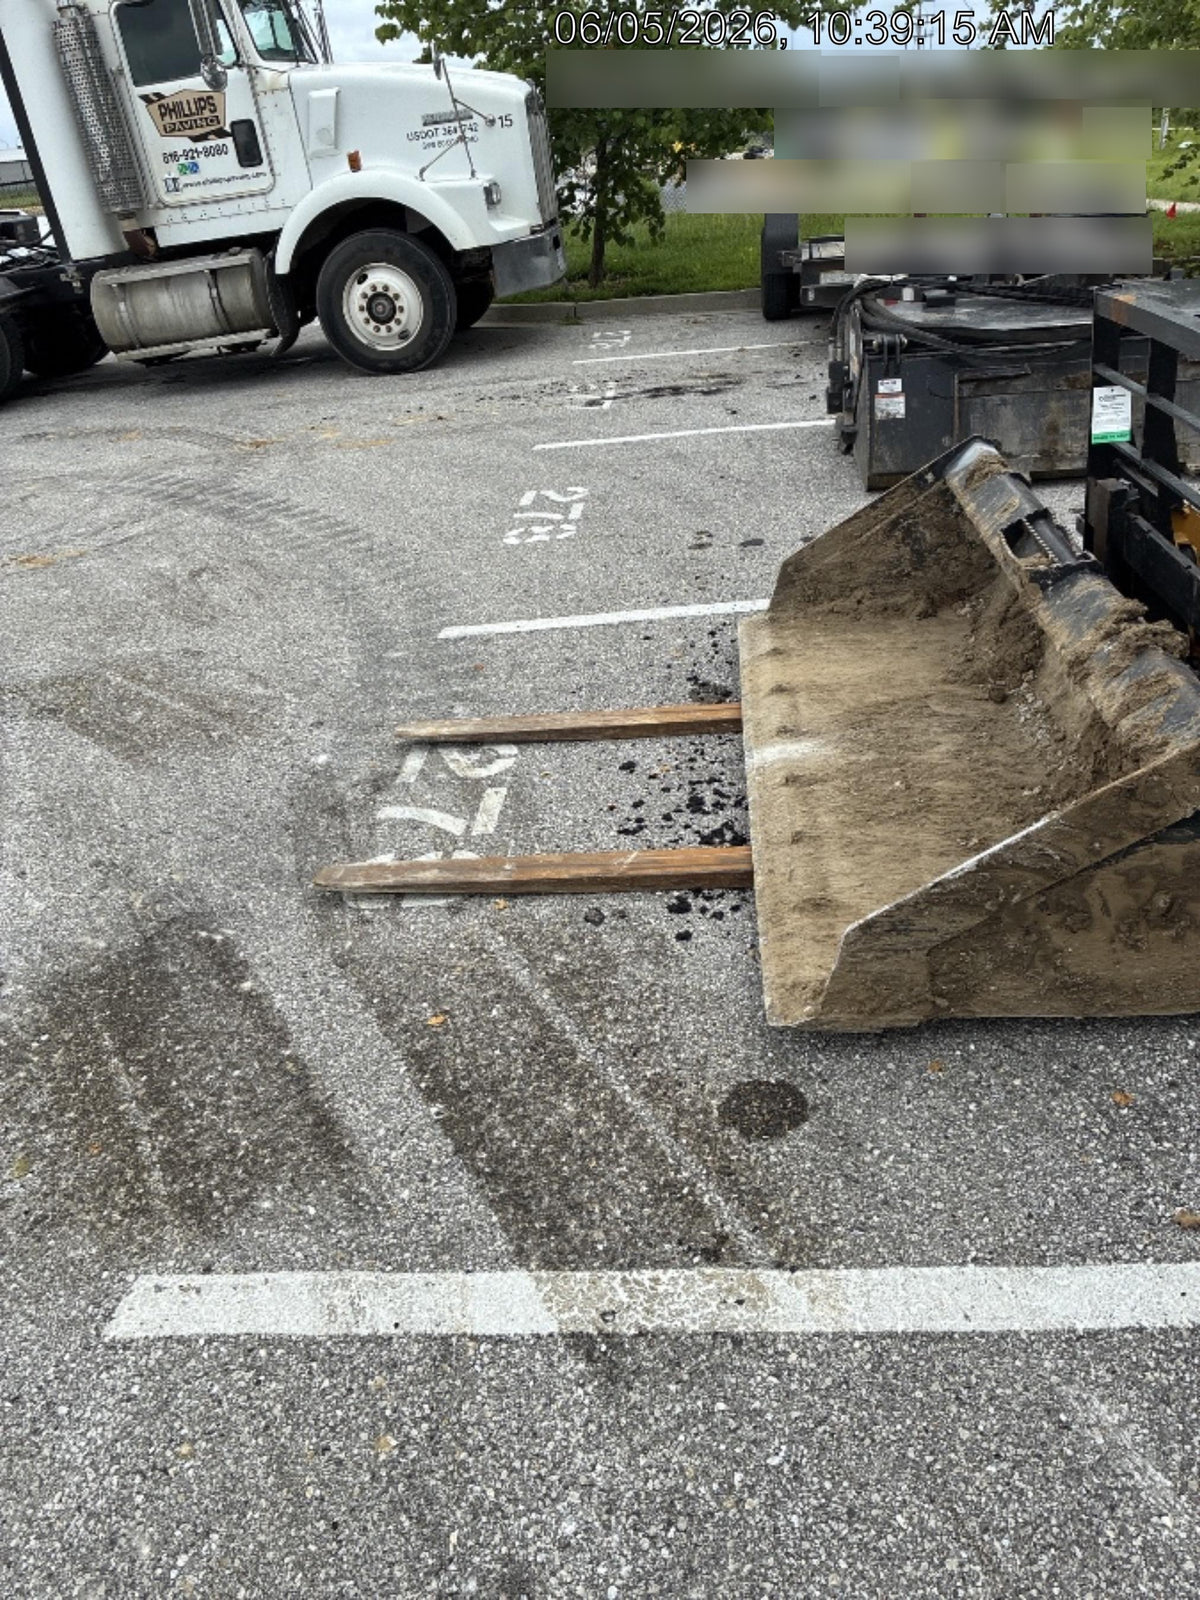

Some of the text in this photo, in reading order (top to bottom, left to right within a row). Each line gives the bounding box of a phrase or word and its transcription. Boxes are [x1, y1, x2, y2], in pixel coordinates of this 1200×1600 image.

[157, 95, 218, 121] PHILLIPS
[163, 115, 220, 133] PAVING
[497, 113, 514, 128] 15
[406, 127, 440, 141] USDOT
[502, 485, 589, 545] 278
